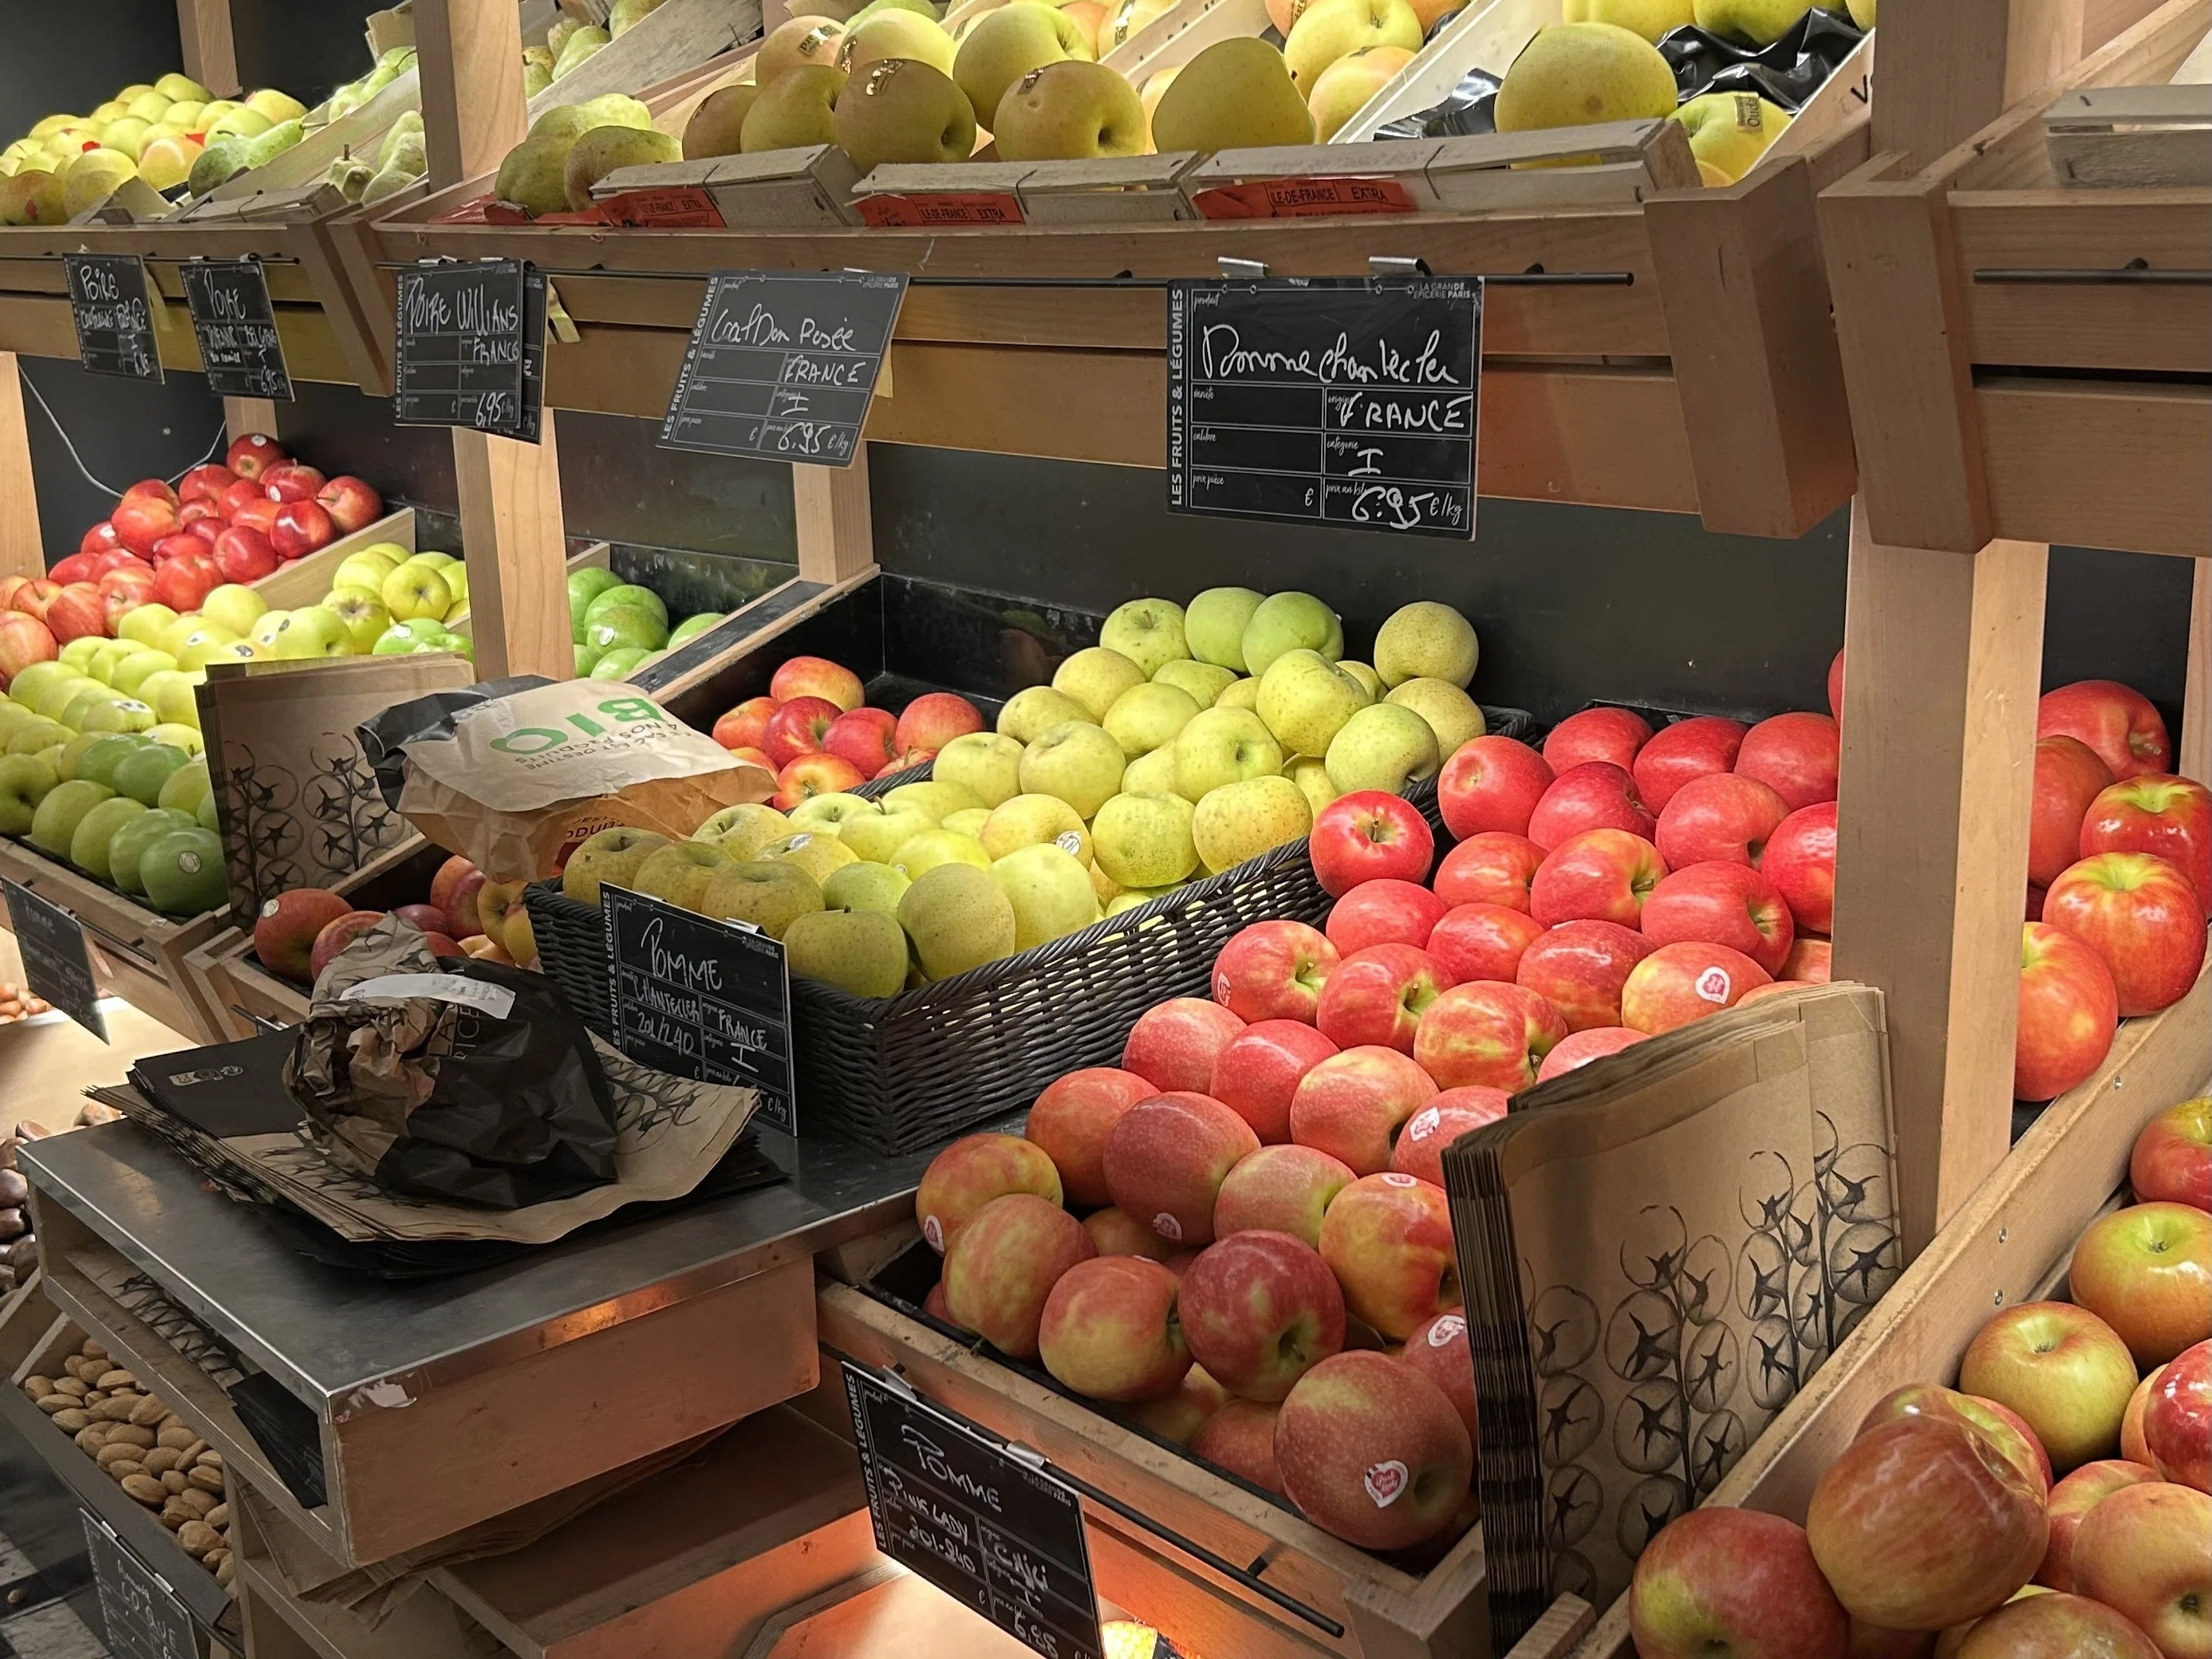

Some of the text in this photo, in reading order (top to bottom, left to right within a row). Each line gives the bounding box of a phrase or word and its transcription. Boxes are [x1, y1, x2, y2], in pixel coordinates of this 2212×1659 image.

[1352, 187, 1386, 201] EXTRA
[977, 209, 1007, 220] EXTRA
[1447, 290, 1471, 299] PARIS
[784, 355, 865, 385] FRANCE
[662, 416, 674, 439] LES
[671, 364, 691, 411] FRUITS
[1172, 290, 1183, 506] LES FRUITS & LÉGUMES
[1348, 448, 1384, 476] I
[1305, 487, 1314, 506] €
[1429, 492, 1463, 525] €/kg
[490, 698, 663, 755] BIO
[620, 722, 662, 739] NOS
[641, 918, 722, 991] POMME
[609, 978, 620, 1026] FRUITS
[719, 1011, 767, 1050] FRANCE
[767, 1097, 787, 1122] €/kg
[901, 1424, 1002, 1513] POMME
[867, 1464, 884, 1519] FRUITS
[876, 1521, 886, 1547] LES
